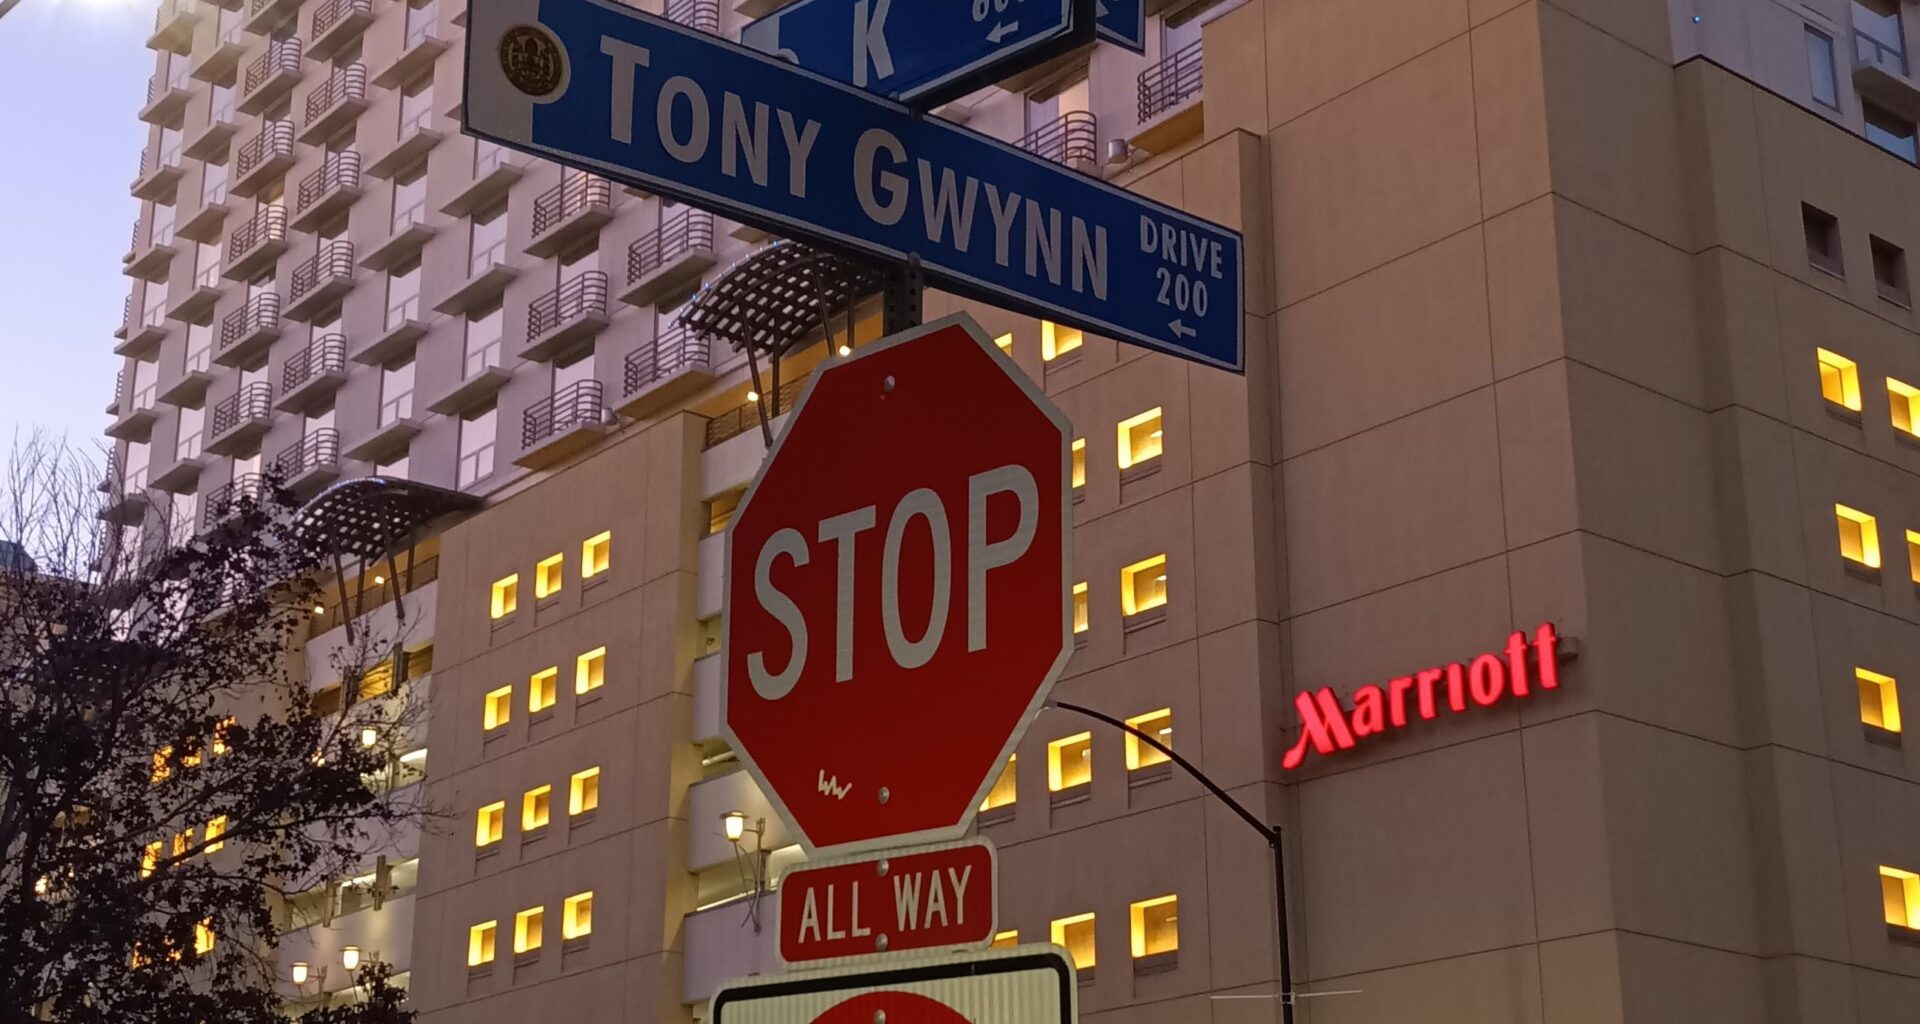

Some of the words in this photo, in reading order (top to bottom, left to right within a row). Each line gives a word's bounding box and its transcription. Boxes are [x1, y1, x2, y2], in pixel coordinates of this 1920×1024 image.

[853, 0, 895, 88] K
[599, 34, 822, 199] TONY
[853, 127, 1108, 301] GWYNN
[1140, 214, 1223, 280] DRIVE
[1156, 266, 1208, 317] 200
[746, 463, 1039, 700] STOP
[1282, 621, 1559, 769] Marriott
[798, 880, 872, 944] ALL
[893, 864, 972, 932] WAY
